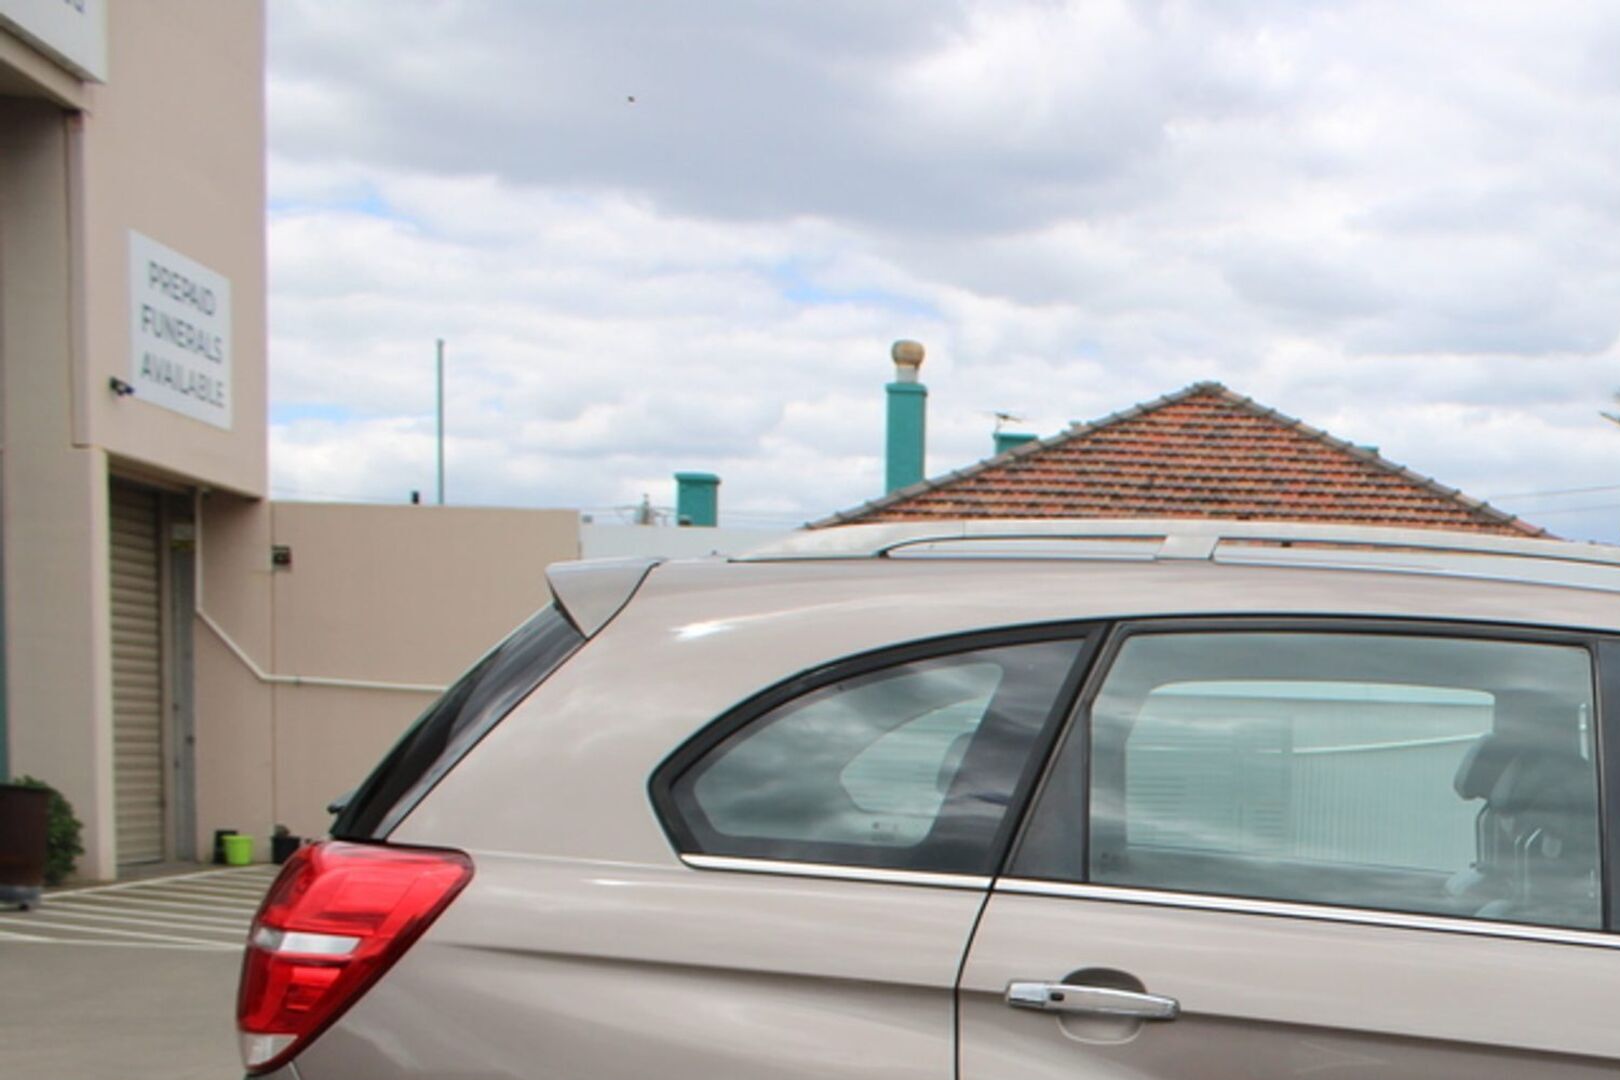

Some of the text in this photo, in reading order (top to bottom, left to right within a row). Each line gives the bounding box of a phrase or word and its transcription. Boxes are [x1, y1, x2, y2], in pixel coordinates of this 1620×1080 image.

[149, 260, 216, 316] PREPAID
[142, 304, 222, 363] FUNERALS
[141, 352, 224, 408] AVAILABLE
